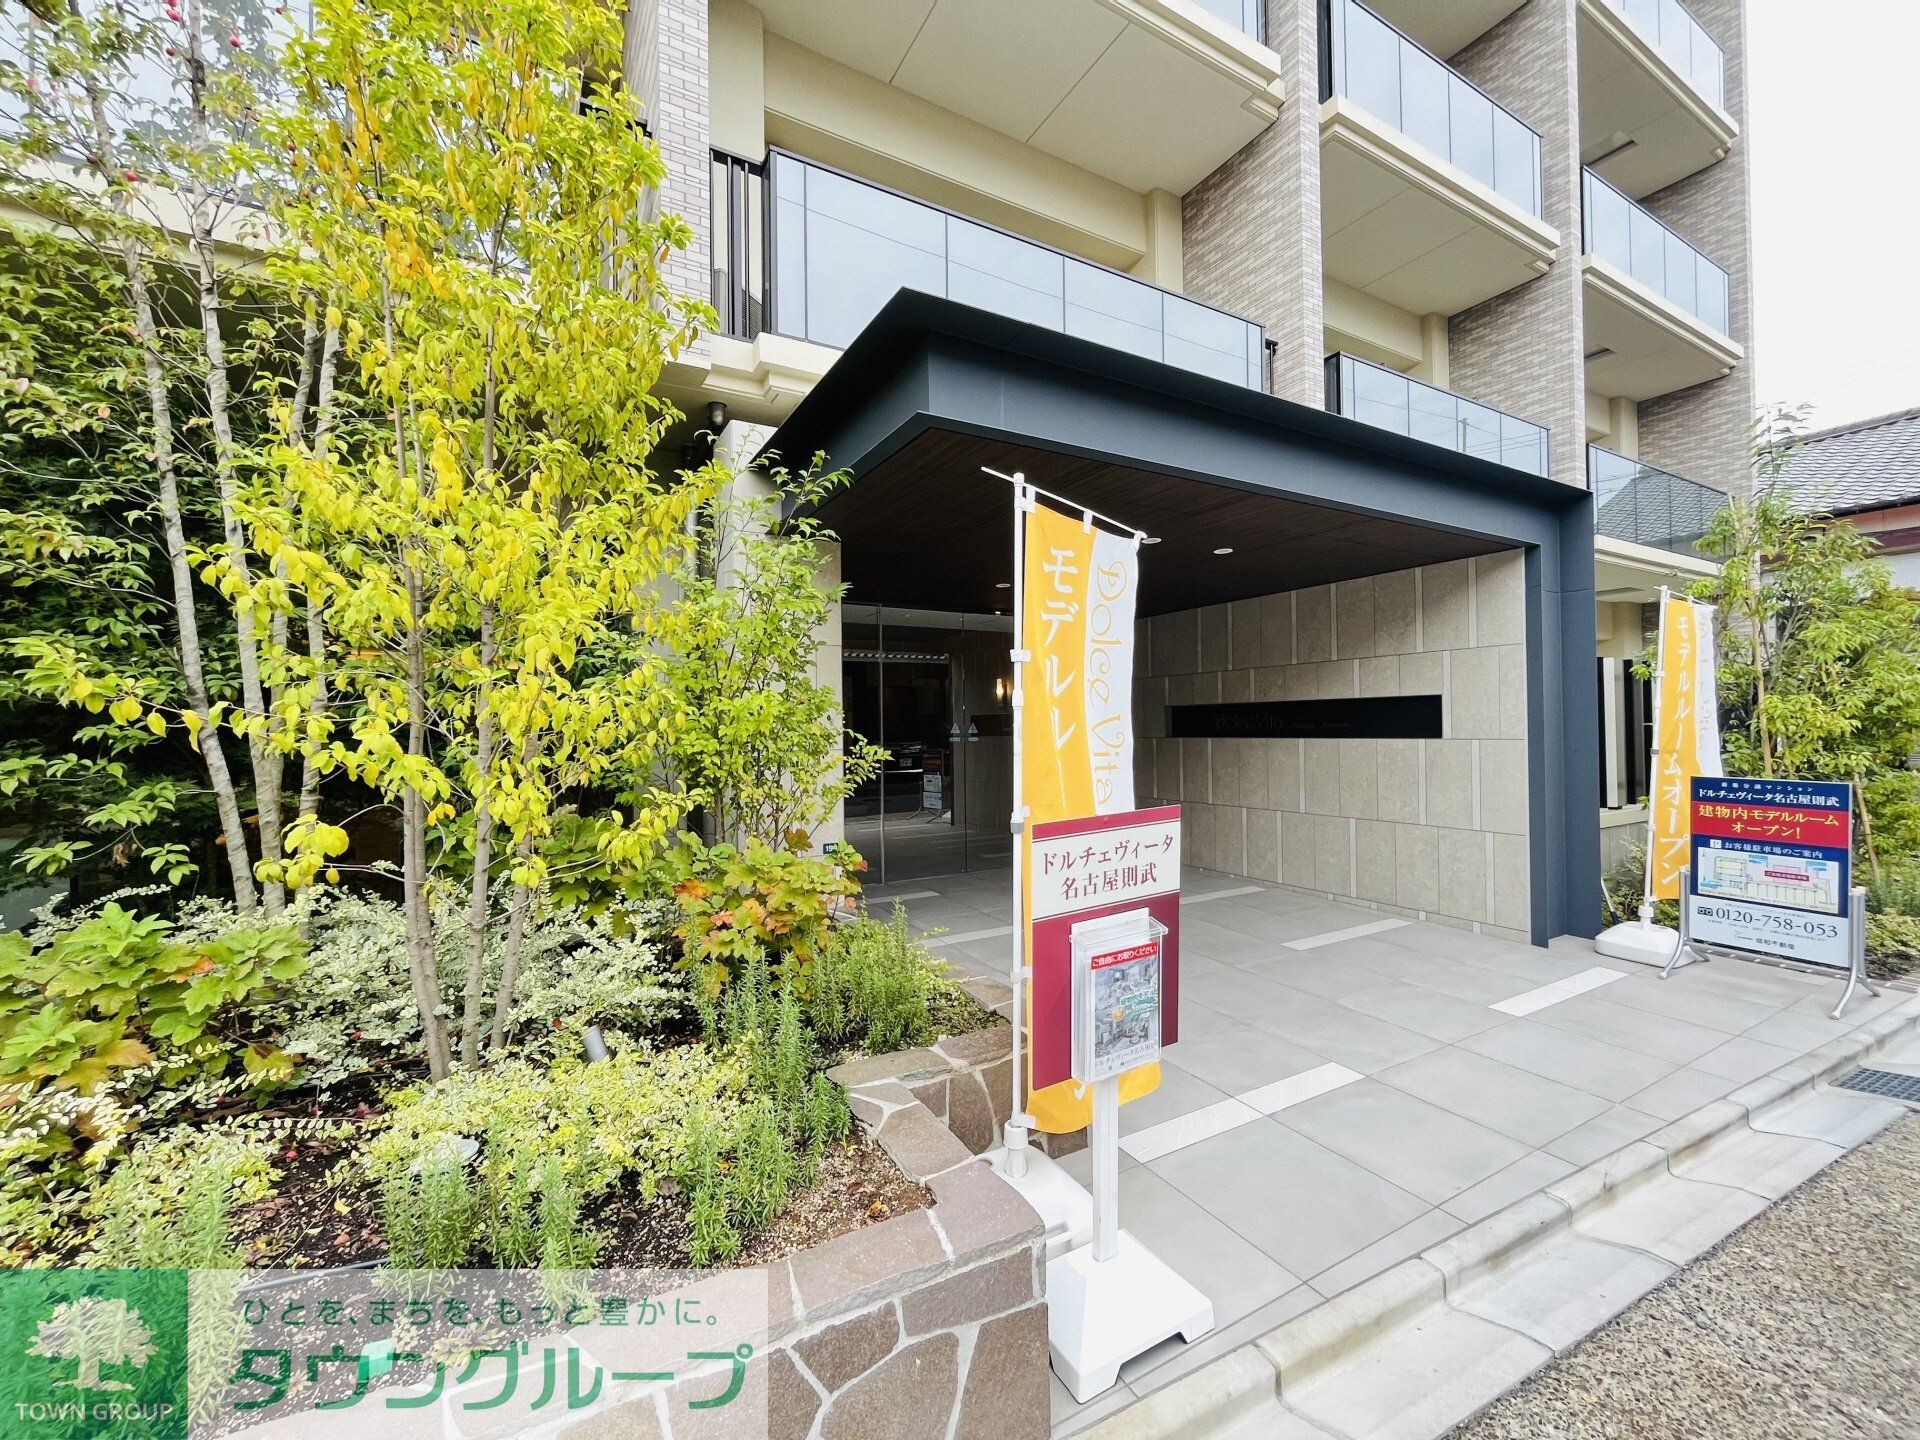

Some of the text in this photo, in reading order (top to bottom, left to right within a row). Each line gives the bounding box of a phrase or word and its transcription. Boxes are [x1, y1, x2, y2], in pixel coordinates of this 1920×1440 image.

[1089, 560, 1128, 806] Dolce Vita
[1659, 615, 1692, 886] モデルルームオープン
[1698, 788, 1841, 807] ドルチェヴィータ名古屋則武
[1697, 804, 1840, 827] 建物内モデルルーム
[1042, 834, 1175, 876] ドルチェヴィータ
[1724, 841, 1823, 859] お客様駐車場のご案内
[1060, 862, 1158, 901] 名古屋則武
[1716, 907, 1838, 938] 0120-758-053
[1091, 945, 1158, 968] ご自由にお取りください
